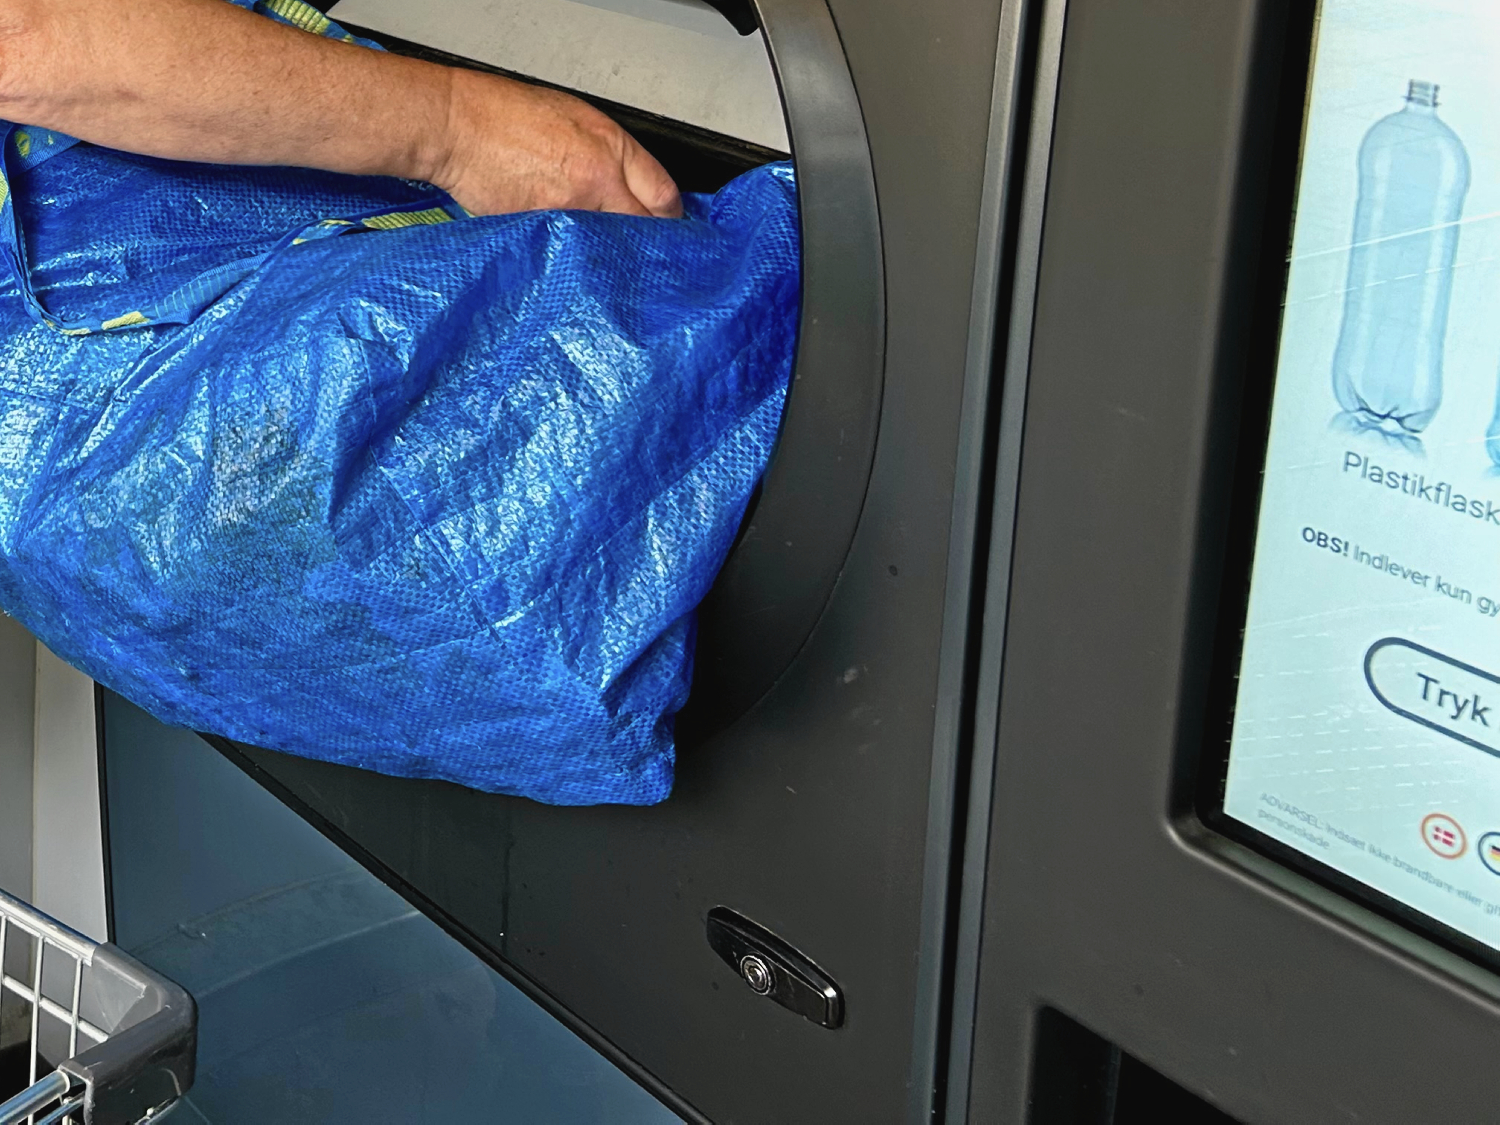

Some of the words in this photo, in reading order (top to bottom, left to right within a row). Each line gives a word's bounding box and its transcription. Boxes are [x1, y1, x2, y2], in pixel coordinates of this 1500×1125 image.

[1343, 451, 1500, 526] Plastikflask
[1302, 526, 1349, 557] OBS!
[1353, 544, 1431, 587] Indlever
[1435, 575, 1472, 604] kun
[1416, 672, 1491, 727] Tryk
